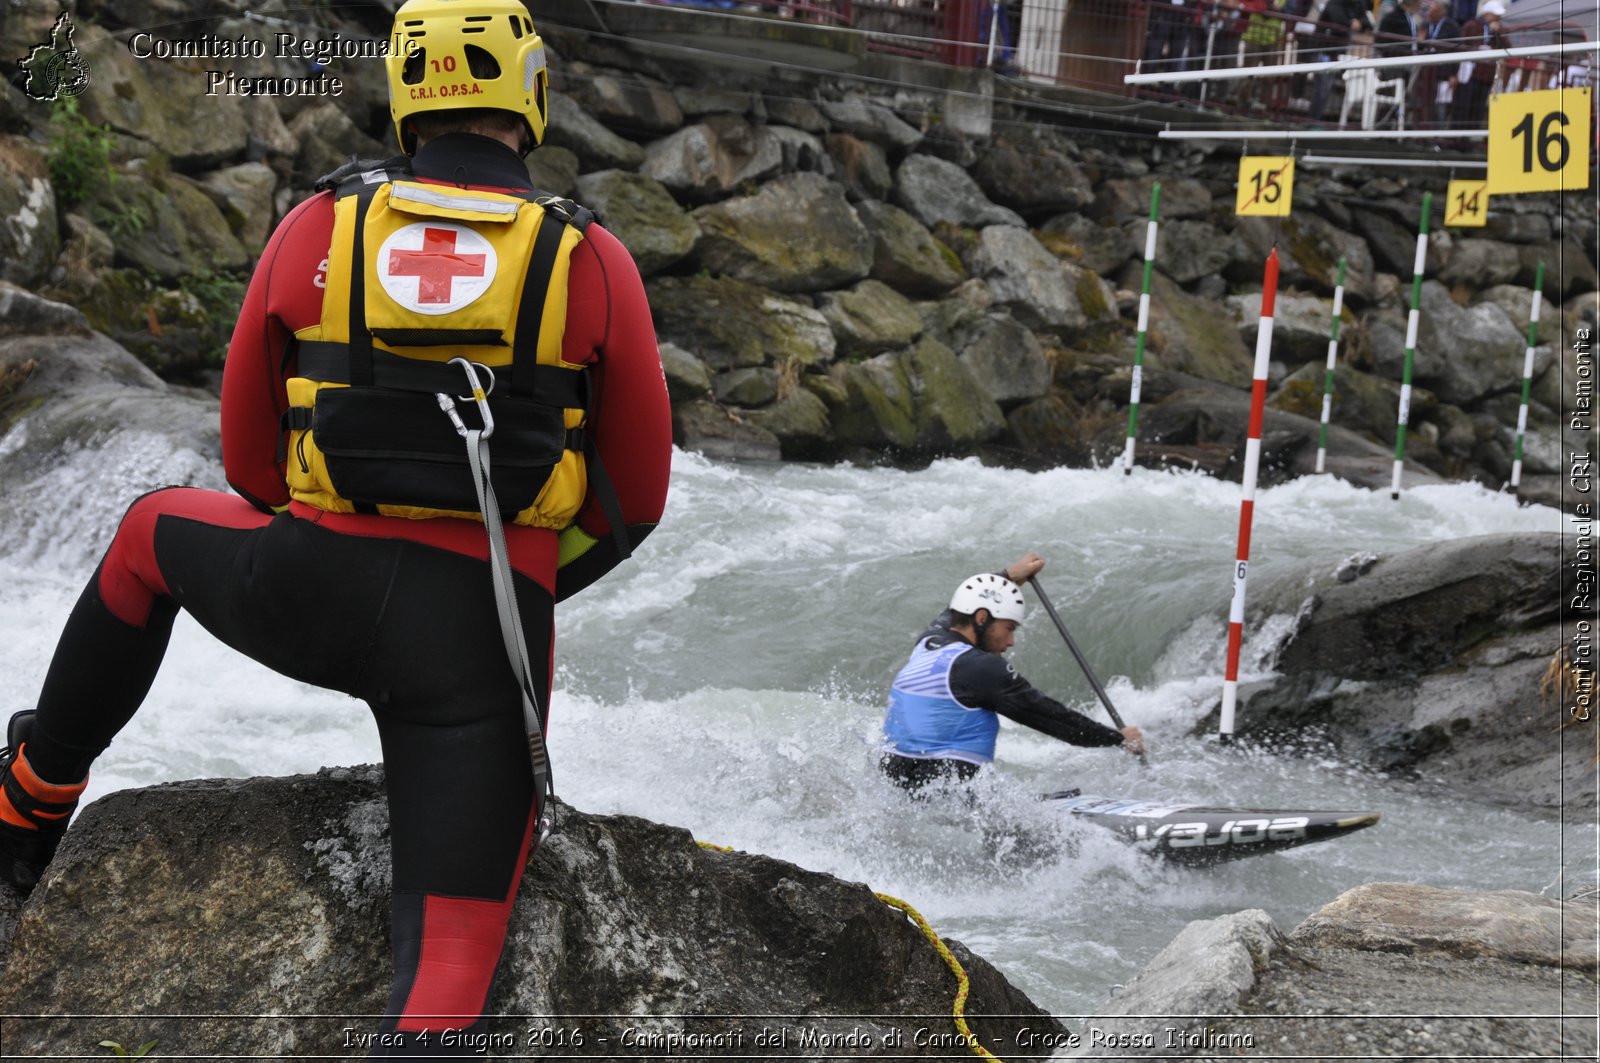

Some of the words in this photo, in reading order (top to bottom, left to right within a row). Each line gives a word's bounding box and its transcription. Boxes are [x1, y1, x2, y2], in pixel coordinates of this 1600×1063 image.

[430, 55, 456, 73] 10
[410, 86, 436, 100] C.R.I.
[439, 83, 483, 97] O.P.S.A.
[1511, 111, 1571, 174] 16
[1250, 169, 1282, 204] 15
[1456, 191, 1480, 217] 14
